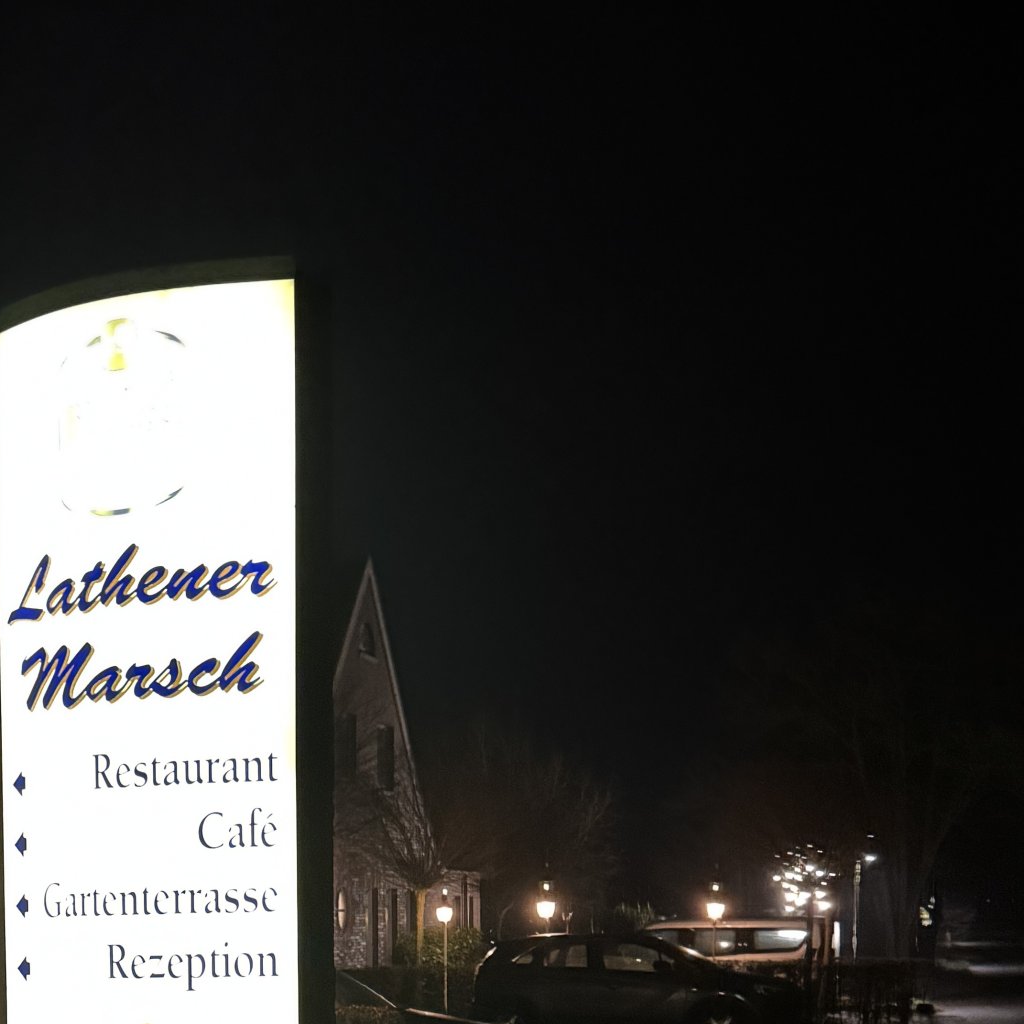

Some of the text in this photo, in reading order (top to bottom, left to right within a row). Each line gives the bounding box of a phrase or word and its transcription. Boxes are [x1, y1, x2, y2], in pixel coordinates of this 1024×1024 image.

[8, 543, 278, 625] Lathener
[21, 631, 264, 712] Marsch
[92, 752, 278, 790] Restaurant
[198, 807, 278, 849] Café
[43, 882, 278, 918] Gartenterrasse
[107, 941, 279, 992] Rezeption
